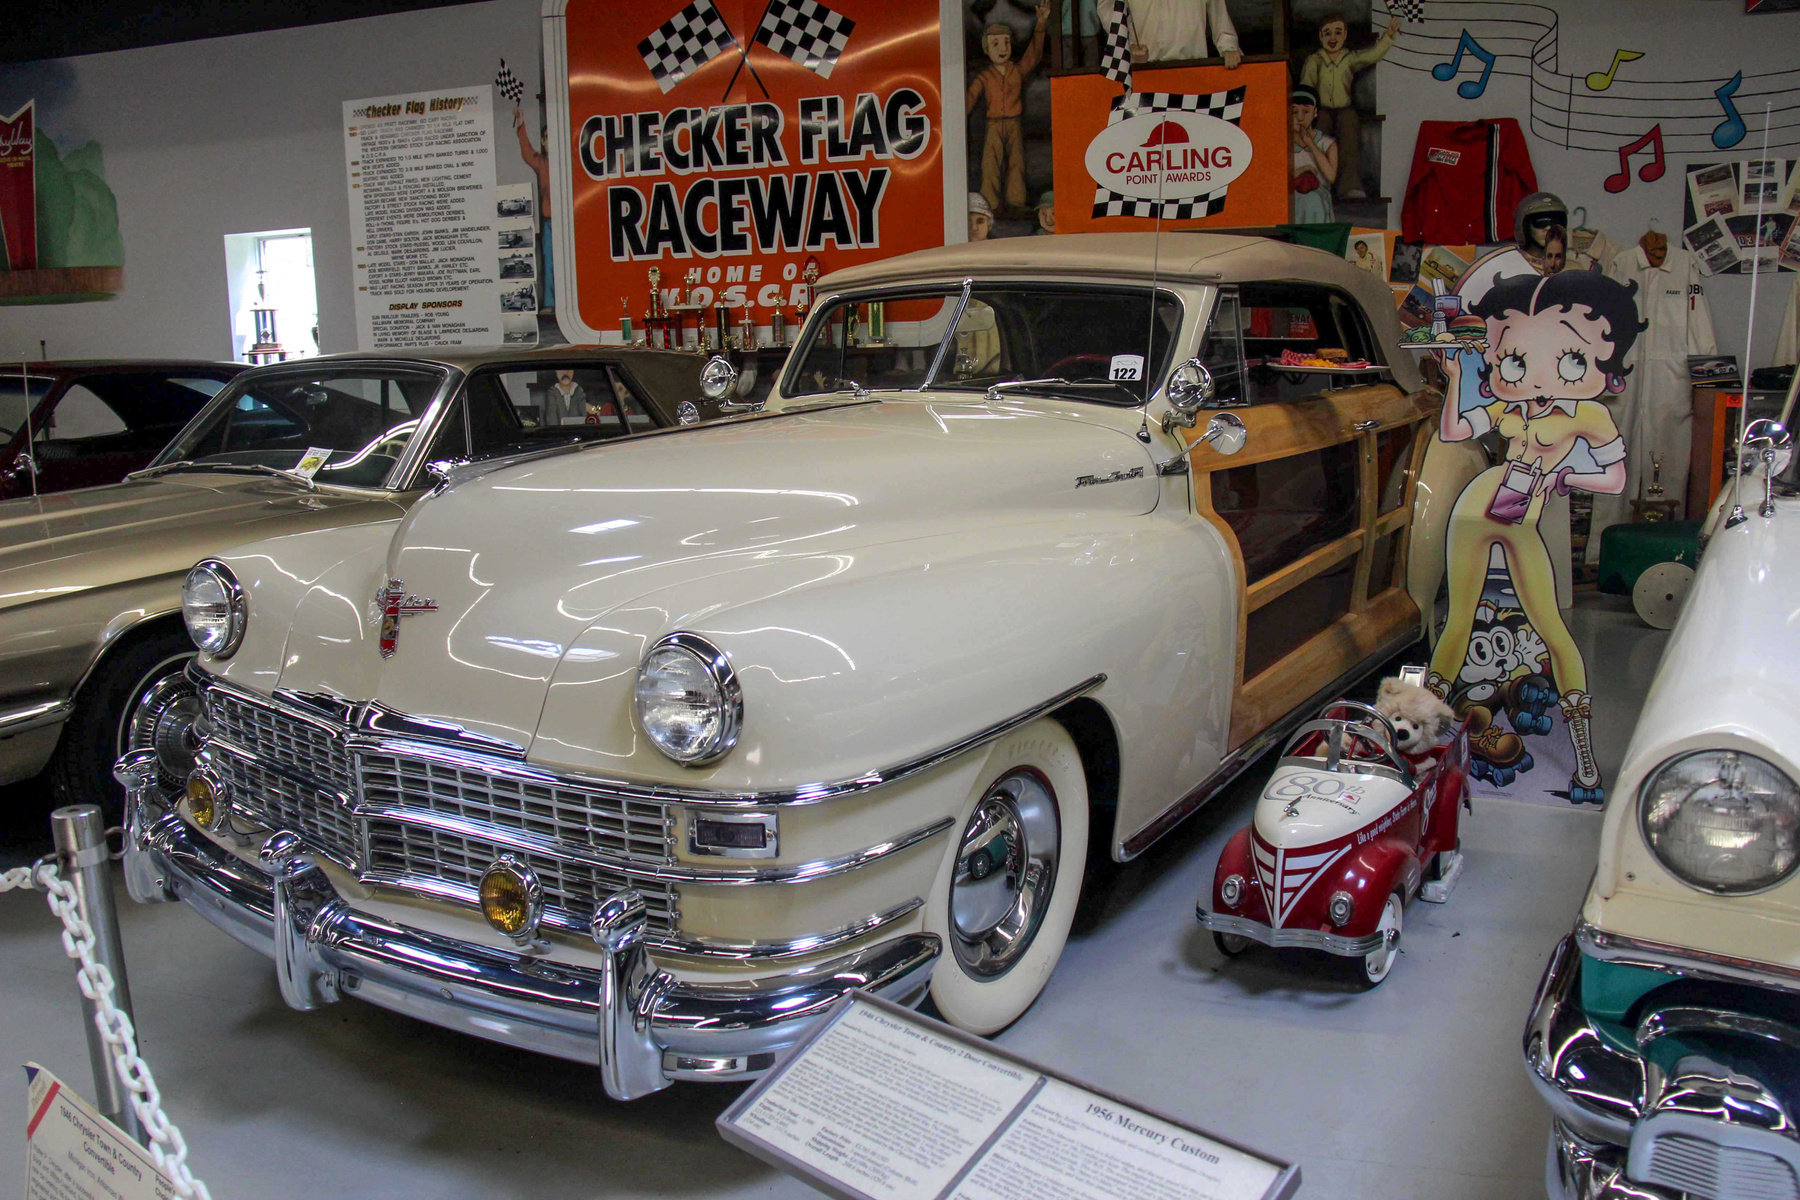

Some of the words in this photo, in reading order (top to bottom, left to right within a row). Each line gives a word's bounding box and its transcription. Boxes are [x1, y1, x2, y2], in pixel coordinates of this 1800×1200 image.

[365, 101, 401, 119] Checker
[405, 99, 425, 116] Flag
[428, 94, 463, 115] History
[579, 102, 789, 180] CHECKER
[798, 87, 931, 166] FLAG
[1105, 146, 1233, 175] CARLING
[1126, 173, 1158, 185] POINT
[1165, 171, 1212, 184] AWARDS
[608, 167, 892, 262] RACEWAY
[688, 265, 763, 284] HOME
[388, 302, 418, 310] DISPLAY
[421, 299, 462, 308] SPONSORS
[1113, 368, 1137, 380] 122
[1301, 793, 1358, 815] Anniversary
[1357, 831, 1367, 845] Like
[1370, 822, 1379, 842] good
[859, 1008, 874, 1021] 1946
[874, 1014, 901, 1032] Chrysler
[903, 1027, 921, 1040] Town
[921, 1035, 928, 1043] &
[929, 1038, 957, 1055] Country
[964, 1051, 982, 1064] Door
[982, 1060, 1024, 1081] Convertible
[60, 1105, 72, 1122] 1946
[72, 1115, 96, 1141] Chrysler
[96, 1134, 112, 1156] Town
[112, 1148, 118, 1160] &
[118, 1151, 142, 1181] Country
[1084, 1102, 1114, 1122] 1956
[1116, 1114, 1169, 1145] Mercury
[1170, 1137, 1221, 1165] Custom
[83, 1141, 115, 1175] Convertible
